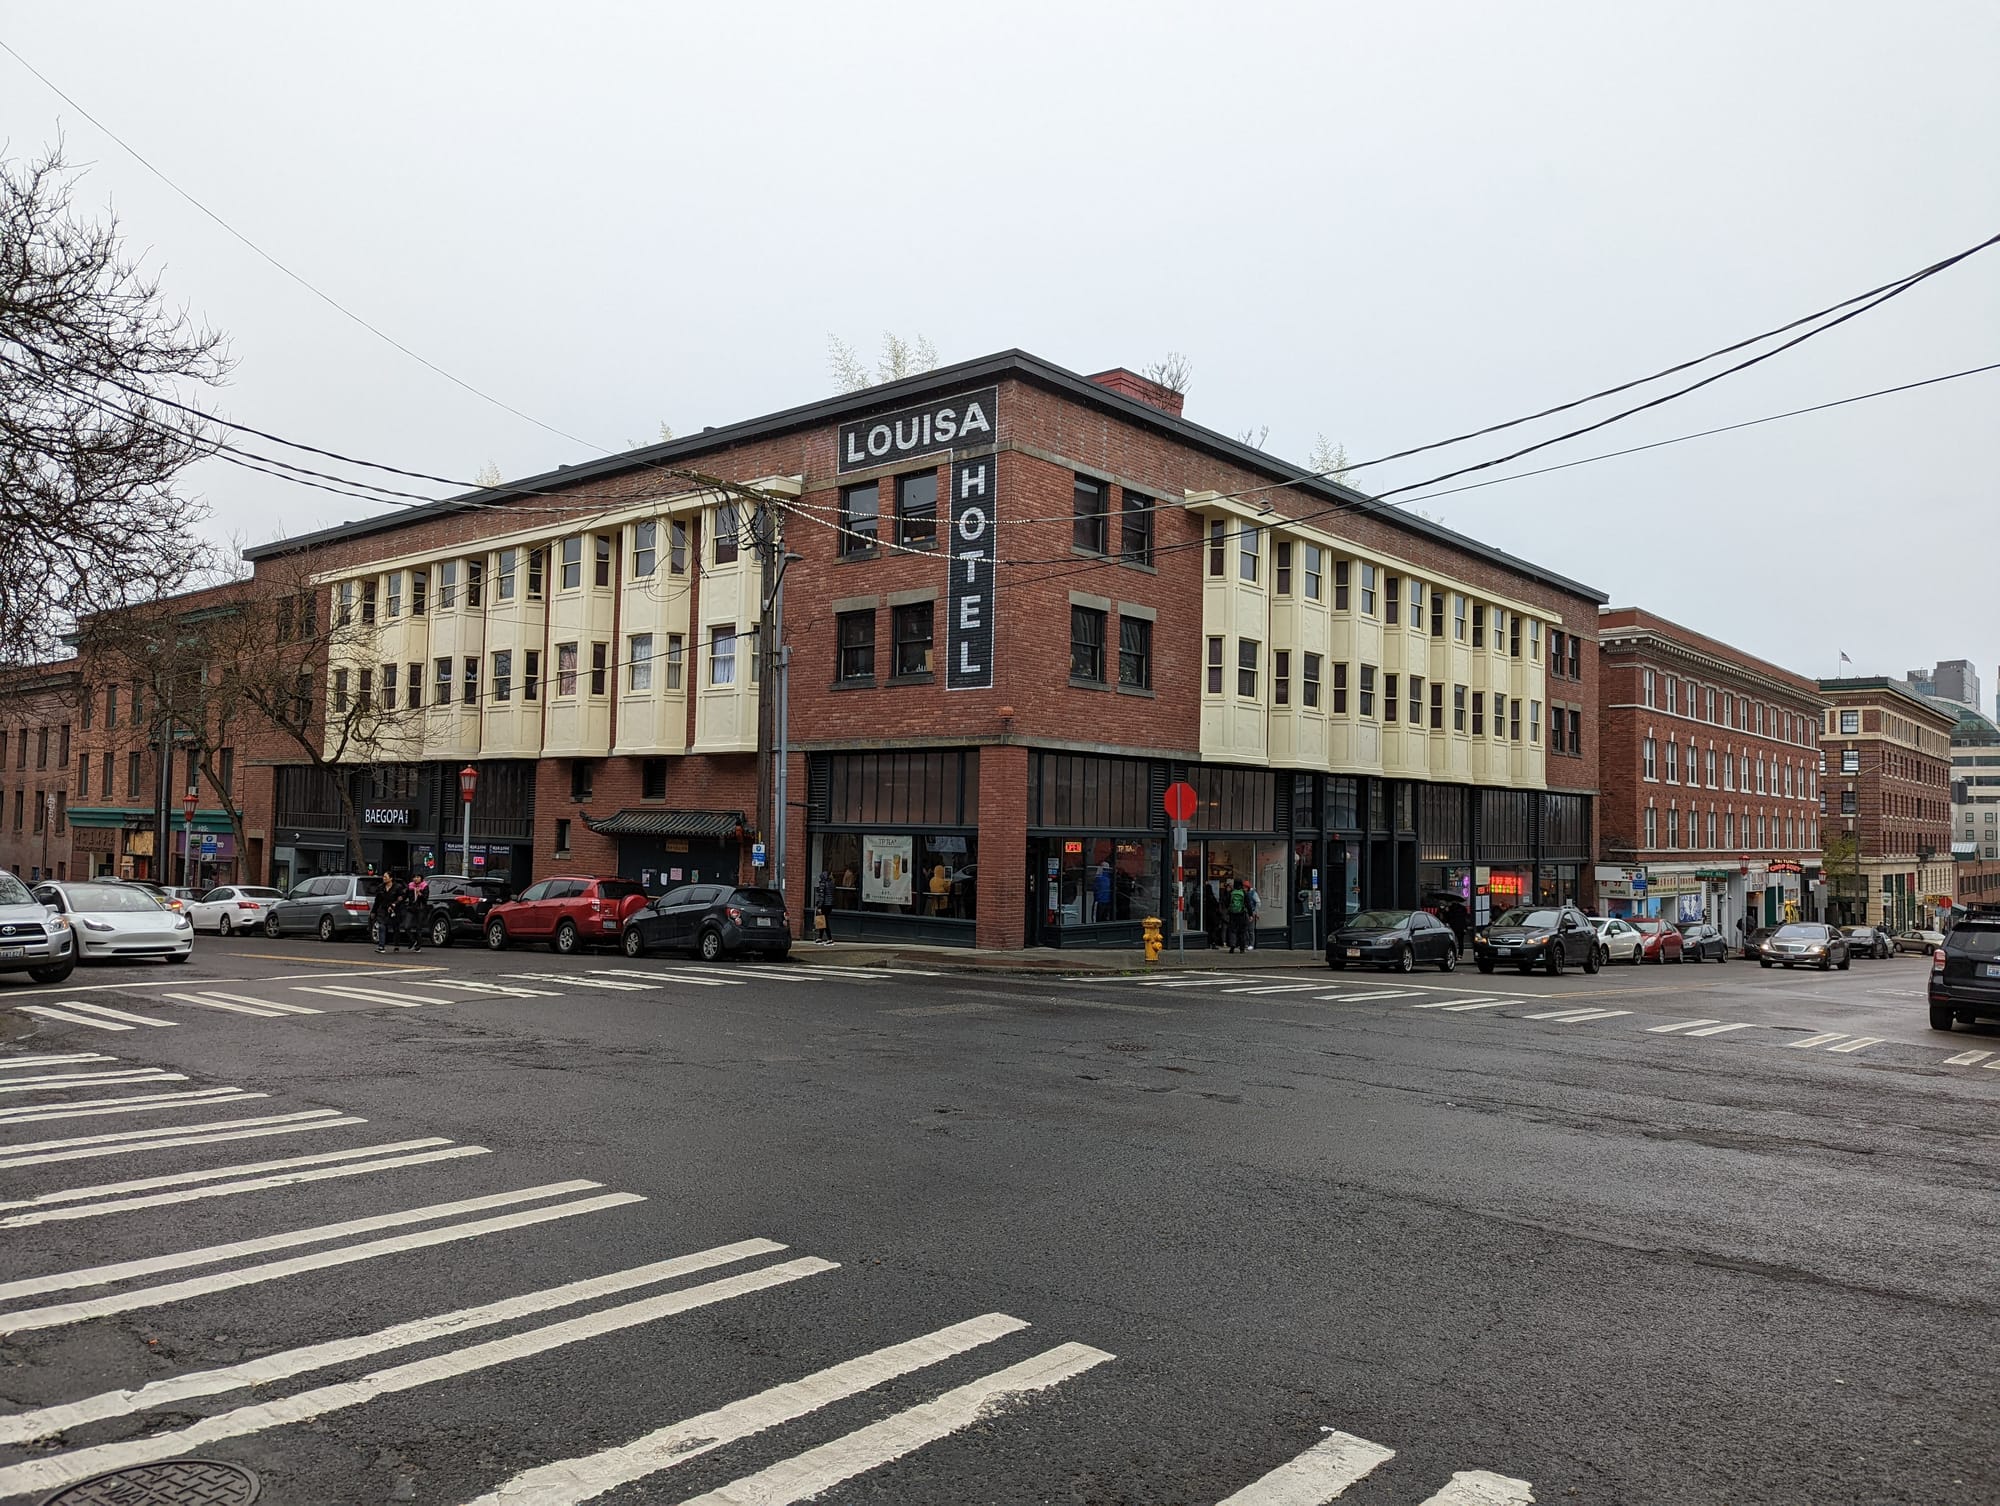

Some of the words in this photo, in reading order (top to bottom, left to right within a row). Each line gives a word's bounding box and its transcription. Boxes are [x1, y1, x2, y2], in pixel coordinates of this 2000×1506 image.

[847, 402, 991, 463] LOUISA
[958, 464, 986, 673] HOTEL
[365, 808, 404, 823] BAEGOPA
